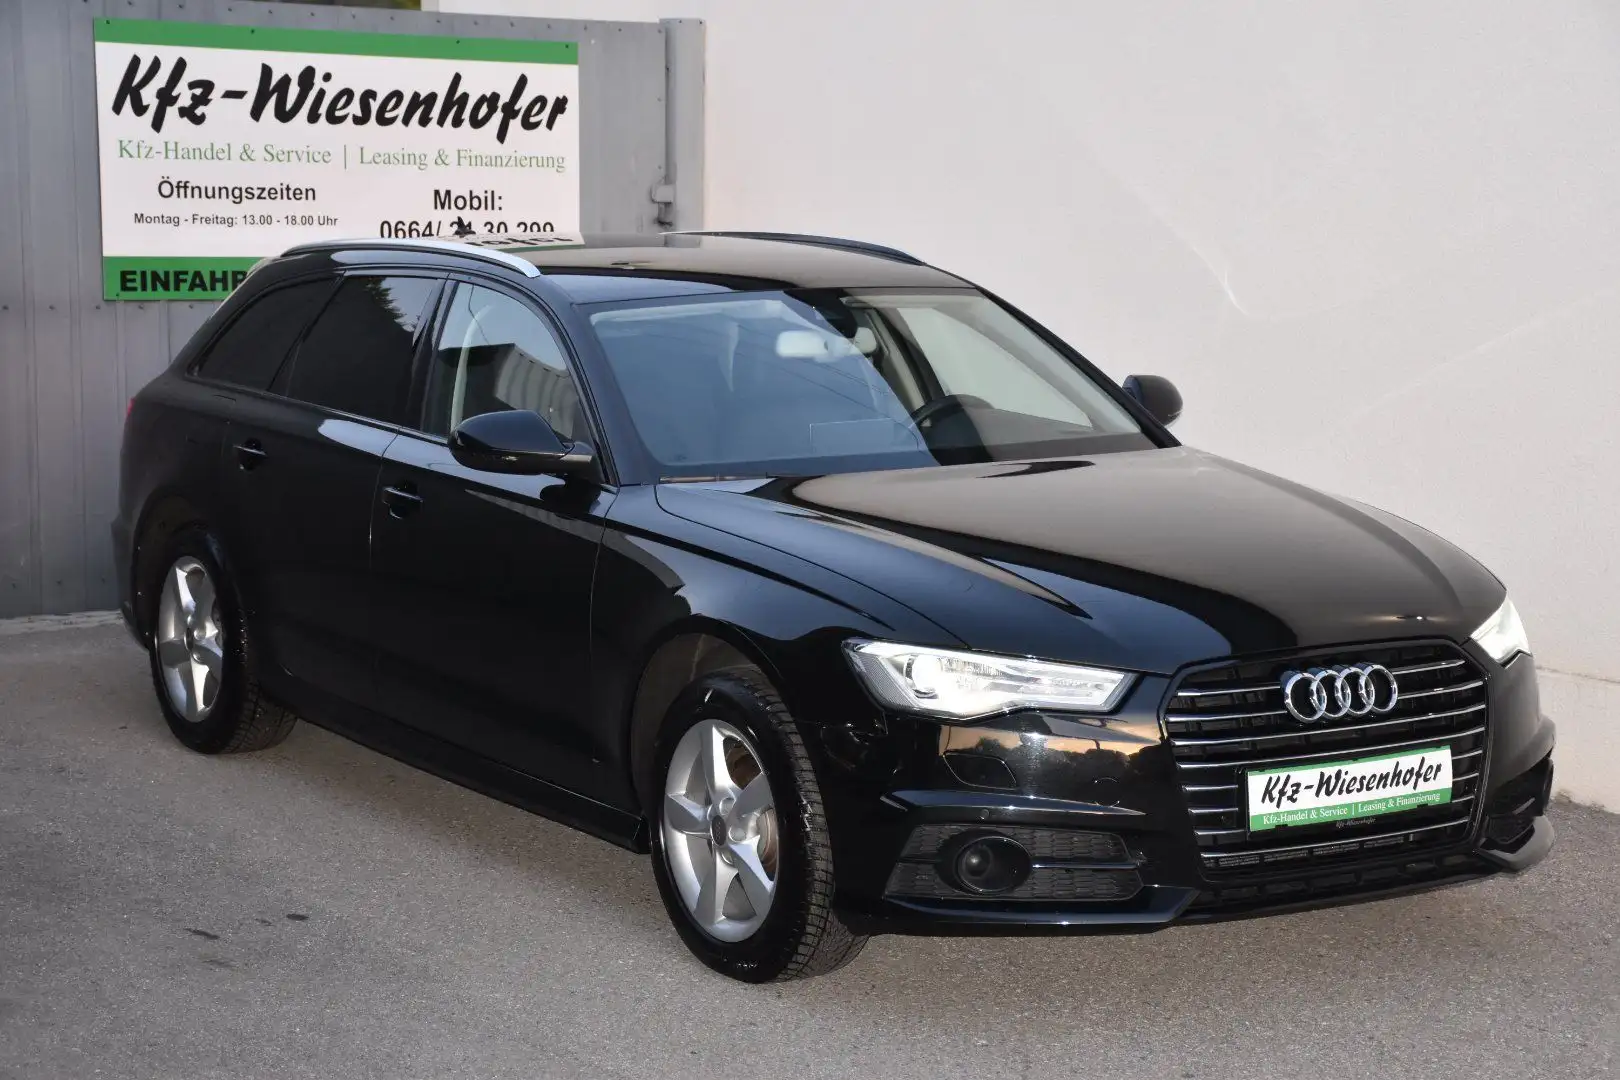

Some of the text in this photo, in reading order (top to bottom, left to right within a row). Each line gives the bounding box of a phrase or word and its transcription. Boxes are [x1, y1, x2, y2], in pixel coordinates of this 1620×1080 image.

[111, 54, 568, 144] Kfz-Wiesenhofer
[118, 139, 232, 161] Kfz-Handel
[239, 143, 256, 162] &
[263, 143, 332, 164] Service
[359, 146, 428, 171] Leasing
[434, 149, 449, 167] &
[456, 149, 565, 174] Finanzierung
[157, 175, 316, 205] Öffnungszeiten
[433, 189, 503, 211] Mobil:
[134, 212, 180, 227] Montag
[192, 213, 238, 228] Freitag:
[242, 214, 273, 226] 13.00
[284, 215, 314, 226] 18.00
[317, 215, 338, 226] Uhr
[380, 220, 442, 239] 0664/
[1261, 756, 1442, 809] Kfz-Wiesenhofer
[1263, 810, 1308, 825] Kfz-Handel
[1310, 809, 1318, 818] &
[1320, 806, 1348, 817] Service
[1358, 800, 1387, 813] Leasing
[1388, 800, 1395, 808] &
[1396, 792, 1441, 807] Finanzierung
